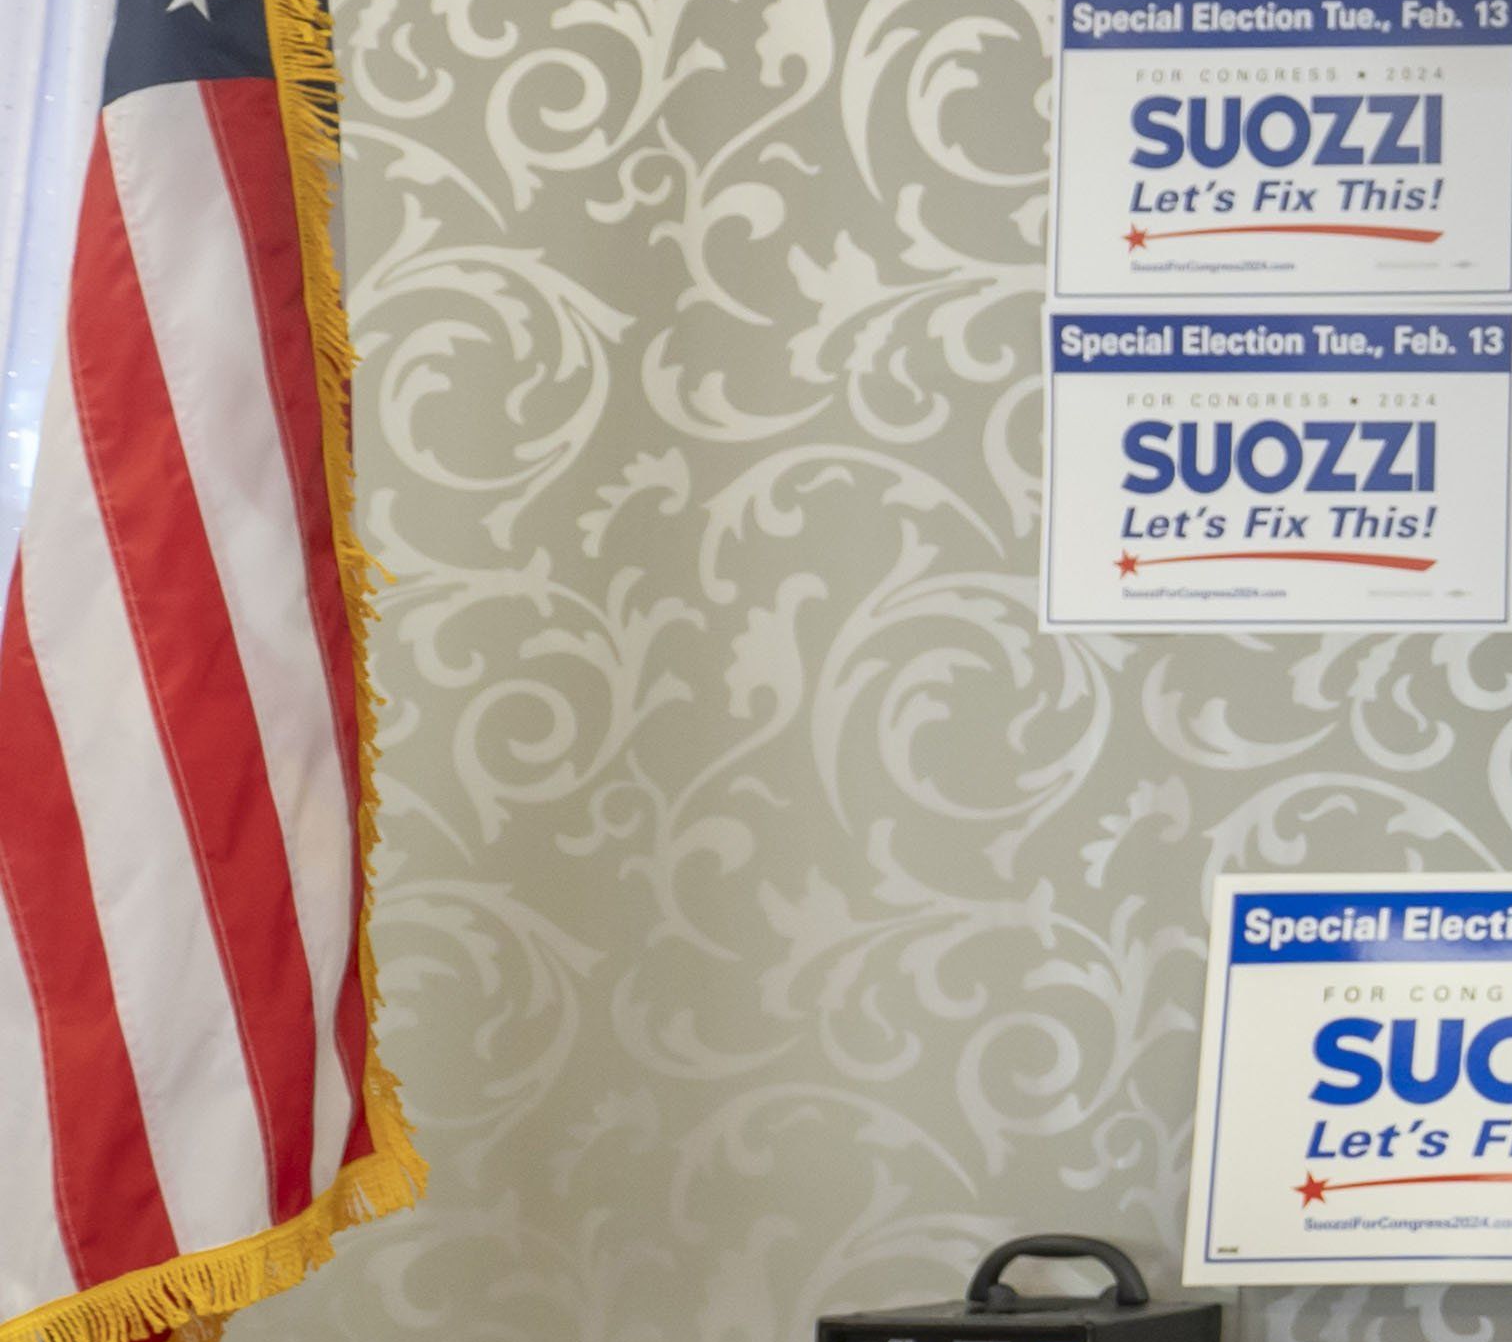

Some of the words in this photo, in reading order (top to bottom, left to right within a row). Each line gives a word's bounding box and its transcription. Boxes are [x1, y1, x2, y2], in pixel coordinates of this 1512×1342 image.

[1073, 3, 1183, 37] Special
[1192, 2, 1313, 31] Election
[1322, 1, 1391, 32] Tue.,
[1402, 0, 1462, 28] Feb.
[1475, 0, 1508, 27] 13
[1136, 69, 1183, 84] FOR
[1200, 67, 1336, 83] CONGRESS
[1387, 67, 1444, 82] 2024
[1131, 94, 1443, 169] SUOZZI
[1130, 181, 1235, 213] Let's
[1254, 181, 1316, 211] Fix
[1338, 179, 1443, 210] This!
[1061, 325, 1173, 360] Special
[1183, 326, 1305, 355] Election
[1313, 326, 1383, 358] Tue.,
[1395, 326, 1456, 354] Feb.
[1469, 326, 1503, 355] 13
[1127, 393, 1174, 408] FOR
[1190, 393, 1329, 408] CONGRESS
[1379, 393, 1436, 408] 2024
[1122, 420, 1436, 494] SUOZZI
[1122, 507, 1226, 538] Let's
[1245, 507, 1308, 538] Fix
[1330, 507, 1437, 538] This!
[1244, 907, 1389, 950] Special
[1323, 986, 1384, 1003] FOR
[1306, 1120, 1449, 1158] Let's
